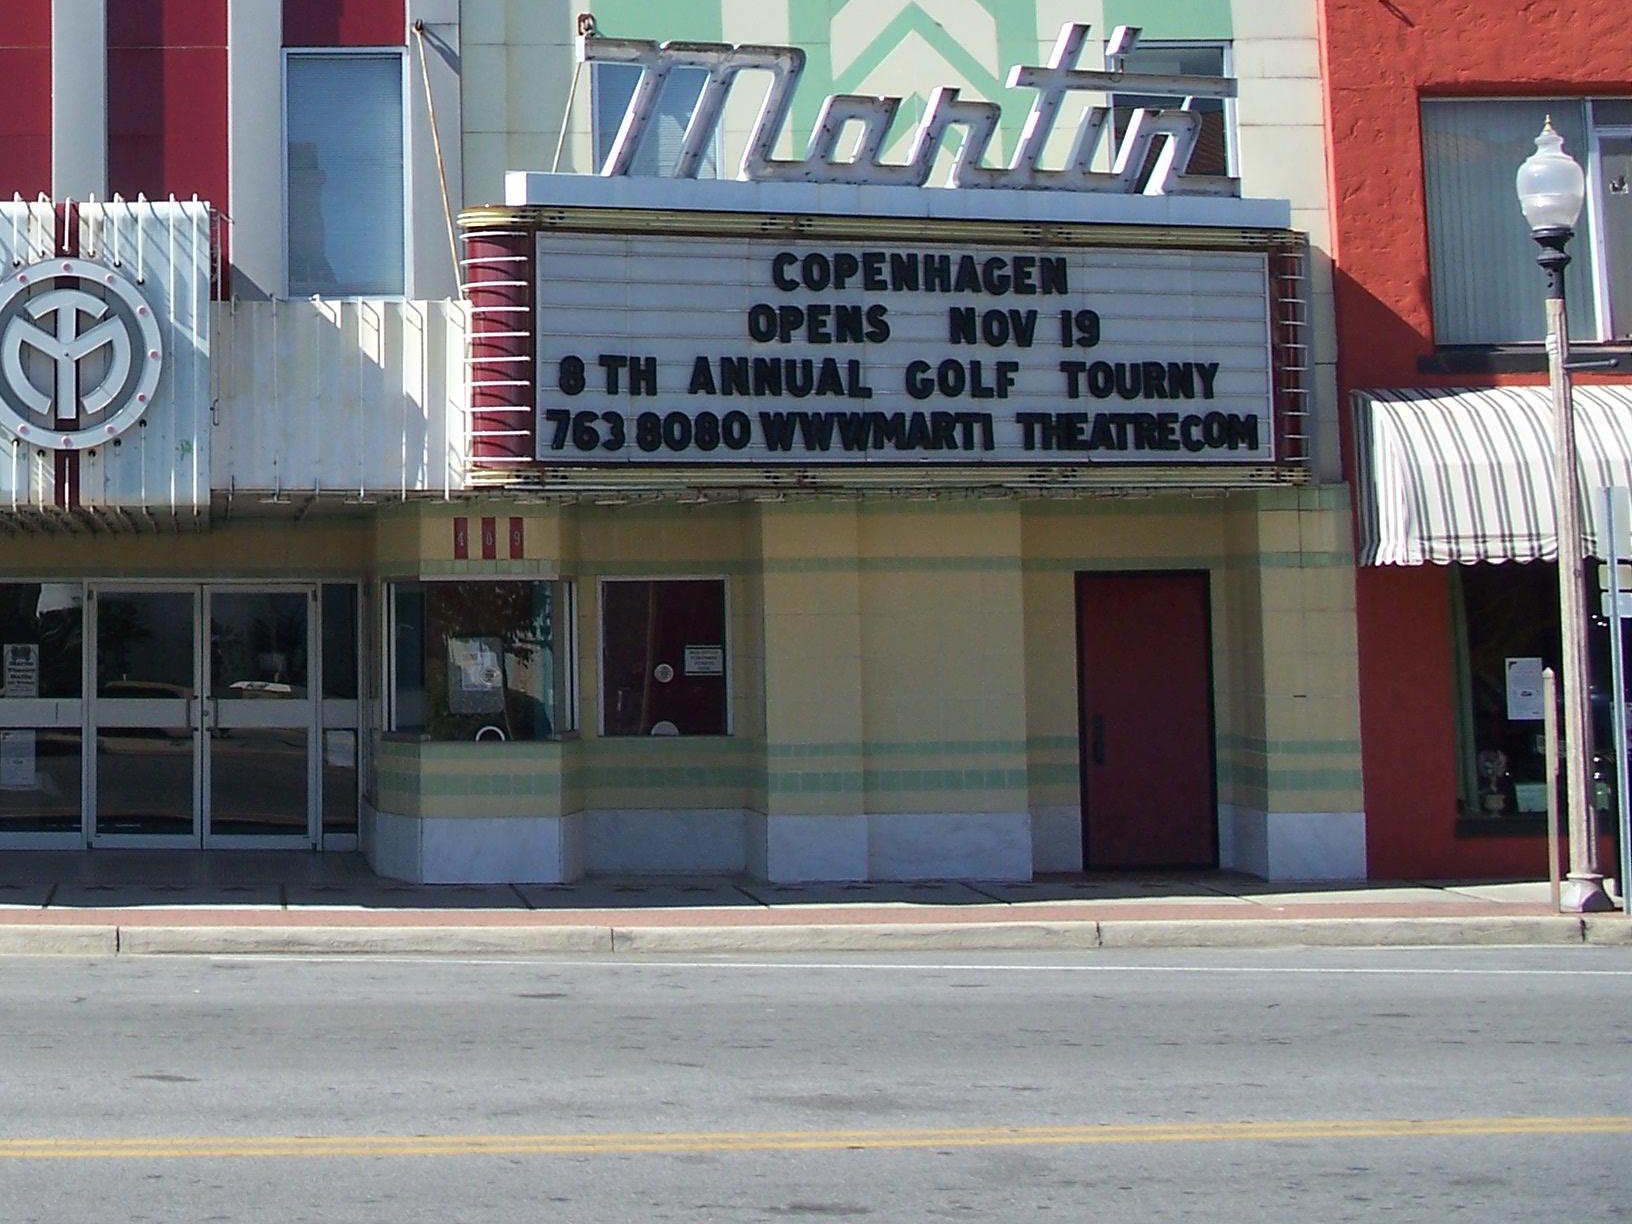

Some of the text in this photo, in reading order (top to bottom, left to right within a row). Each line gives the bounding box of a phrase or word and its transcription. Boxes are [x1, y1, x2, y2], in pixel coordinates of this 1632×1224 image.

[572, 22, 1242, 197] Martin
[772, 252, 1068, 296] COPENHAGEN
[748, 304, 1100, 348] OPENS NOV 19
[687, 356, 873, 399] ANNUAL
[905, 359, 1019, 400] GOLF
[1059, 361, 1219, 400] TOURNY
[545, 409, 625, 452] 763
[635, 410, 751, 452] 8080
